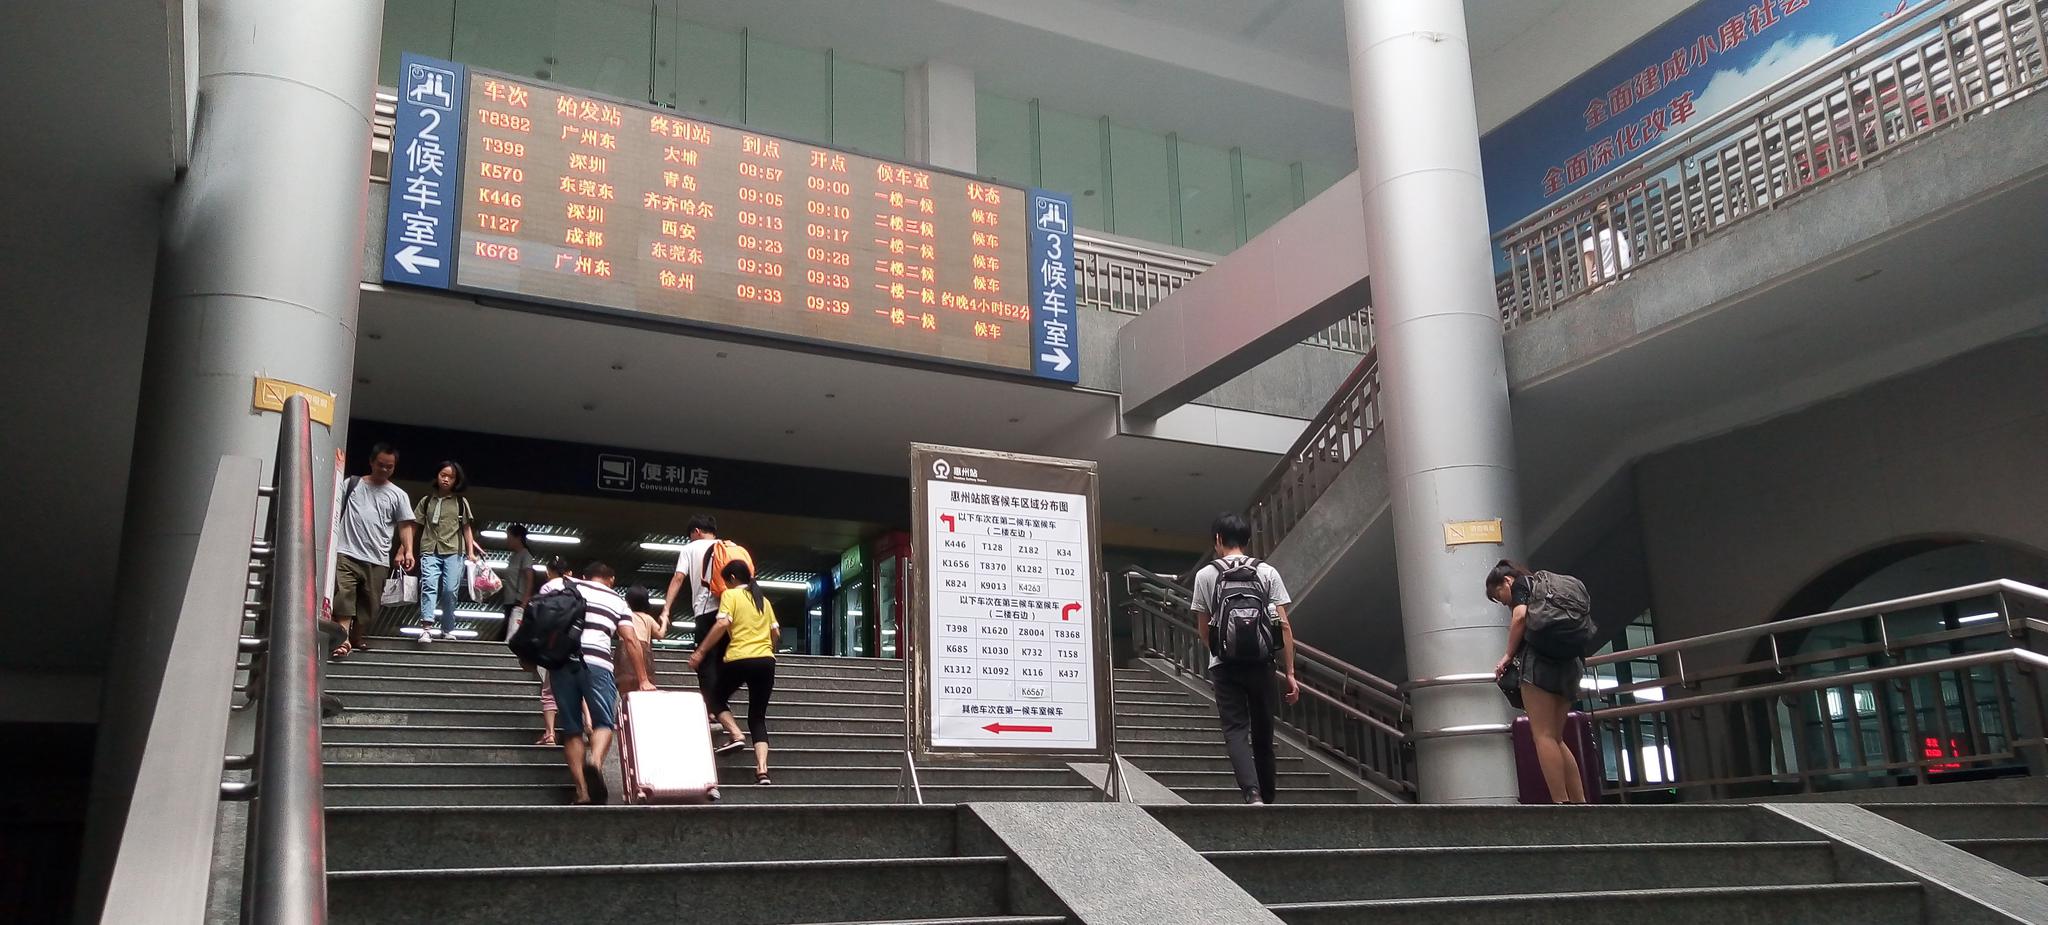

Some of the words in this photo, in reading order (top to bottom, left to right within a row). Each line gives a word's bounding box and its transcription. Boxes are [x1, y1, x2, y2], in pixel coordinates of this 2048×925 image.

[484, 80, 528, 108] 车次
[556, 95, 622, 128] 始发站
[650, 115, 712, 146] 终到站
[742, 135, 781, 160] 到点
[810, 150, 847, 173] 开点
[877, 163, 930, 190] 候车室
[967, 183, 1000, 206] 状态
[1541, 89, 1696, 198] 全面深化改革
[479, 109, 531, 133] T8382
[561, 125, 616, 150] 广州东
[664, 146, 699, 167] 大埔
[739, 162, 783, 182] 08:57
[807, 176, 850, 197] 09:00
[874, 191, 935, 214] 一楼一候
[971, 208, 998, 227] 候车
[482, 137, 525, 158] T398
[569, 152, 606, 175] 深圳
[663, 170, 697, 192] 青岛
[738, 187, 783, 208] 09:05
[807, 200, 850, 220] 09:10
[874, 214, 935, 239] 二楼三候
[972, 231, 999, 249] 候车
[480, 162, 523, 183] K570
[559, 175, 614, 200] 东莞东
[643, 192, 714, 219] 齐齐哈尔
[738, 211, 783, 231] 09:13
[807, 223, 849, 244] 09:17
[874, 237, 935, 261] 一楼一候
[972, 254, 1000, 272] 候车
[479, 187, 522, 208] K446
[567, 202, 604, 224] 深圳
[662, 220, 696, 241] 西安
[738, 235, 783, 254] 09:23
[807, 247, 850, 266] 09:28
[874, 260, 935, 283] 二楼二候
[973, 275, 1000, 293] 候车
[477, 213, 520, 234] T127
[565, 227, 604, 249] 成都
[651, 241, 703, 265] 东莞东
[737, 257, 783, 277] 09:30
[807, 270, 850, 290] 09:33
[875, 282, 936, 305] 一楼一候
[941, 292, 1030, 321] 约晚4小时52分
[475, 241, 519, 262] K678
[554, 253, 611, 278] 广州东
[659, 269, 695, 292] 徐州
[737, 284, 783, 304] 09:33
[806, 296, 850, 315] 09:39
[875, 308, 936, 330] 一楼一候
[974, 320, 1001, 339] 候车
[641, 462, 709, 486] 便利店
[640, 482, 688, 494] Convenience
[690, 487, 711, 496] Store
[950, 490, 1069, 513] 惠州站旅客候车区域分布图
[958, 512, 1056, 530] 以下车次在第二候车室候车
[944, 540, 966, 549] K446
[982, 542, 1003, 552] T128
[1018, 545, 1039, 555] Z182
[1056, 548, 1072, 558] K34
[942, 559, 970, 569] K1656
[980, 561, 1007, 572] T8370
[1016, 564, 1043, 574] K1282
[1055, 567, 1075, 577] T102
[945, 579, 967, 588] K824
[980, 581, 1007, 591] K9013
[1018, 583, 1041, 593] K4263
[959, 595, 1060, 610] 以下车次在第三候车室候车
[946, 624, 968, 633] T398
[981, 626, 1008, 636] K1620
[1018, 628, 1045, 637] Z8004
[1055, 630, 1080, 639] T8368
[946, 644, 968, 654] K685
[982, 646, 1009, 655] K1030
[1021, 648, 1043, 657] K732
[1058, 650, 1079, 658] T158
[944, 664, 972, 674] K1312
[982, 666, 1009, 675] K1092
[1022, 668, 1043, 677] K116
[1058, 669, 1079, 678] K437
[944, 685, 972, 695] K1020
[1021, 687, 1044, 697] K6567
[962, 704, 1063, 716] 其他车次在第一候车室候车
